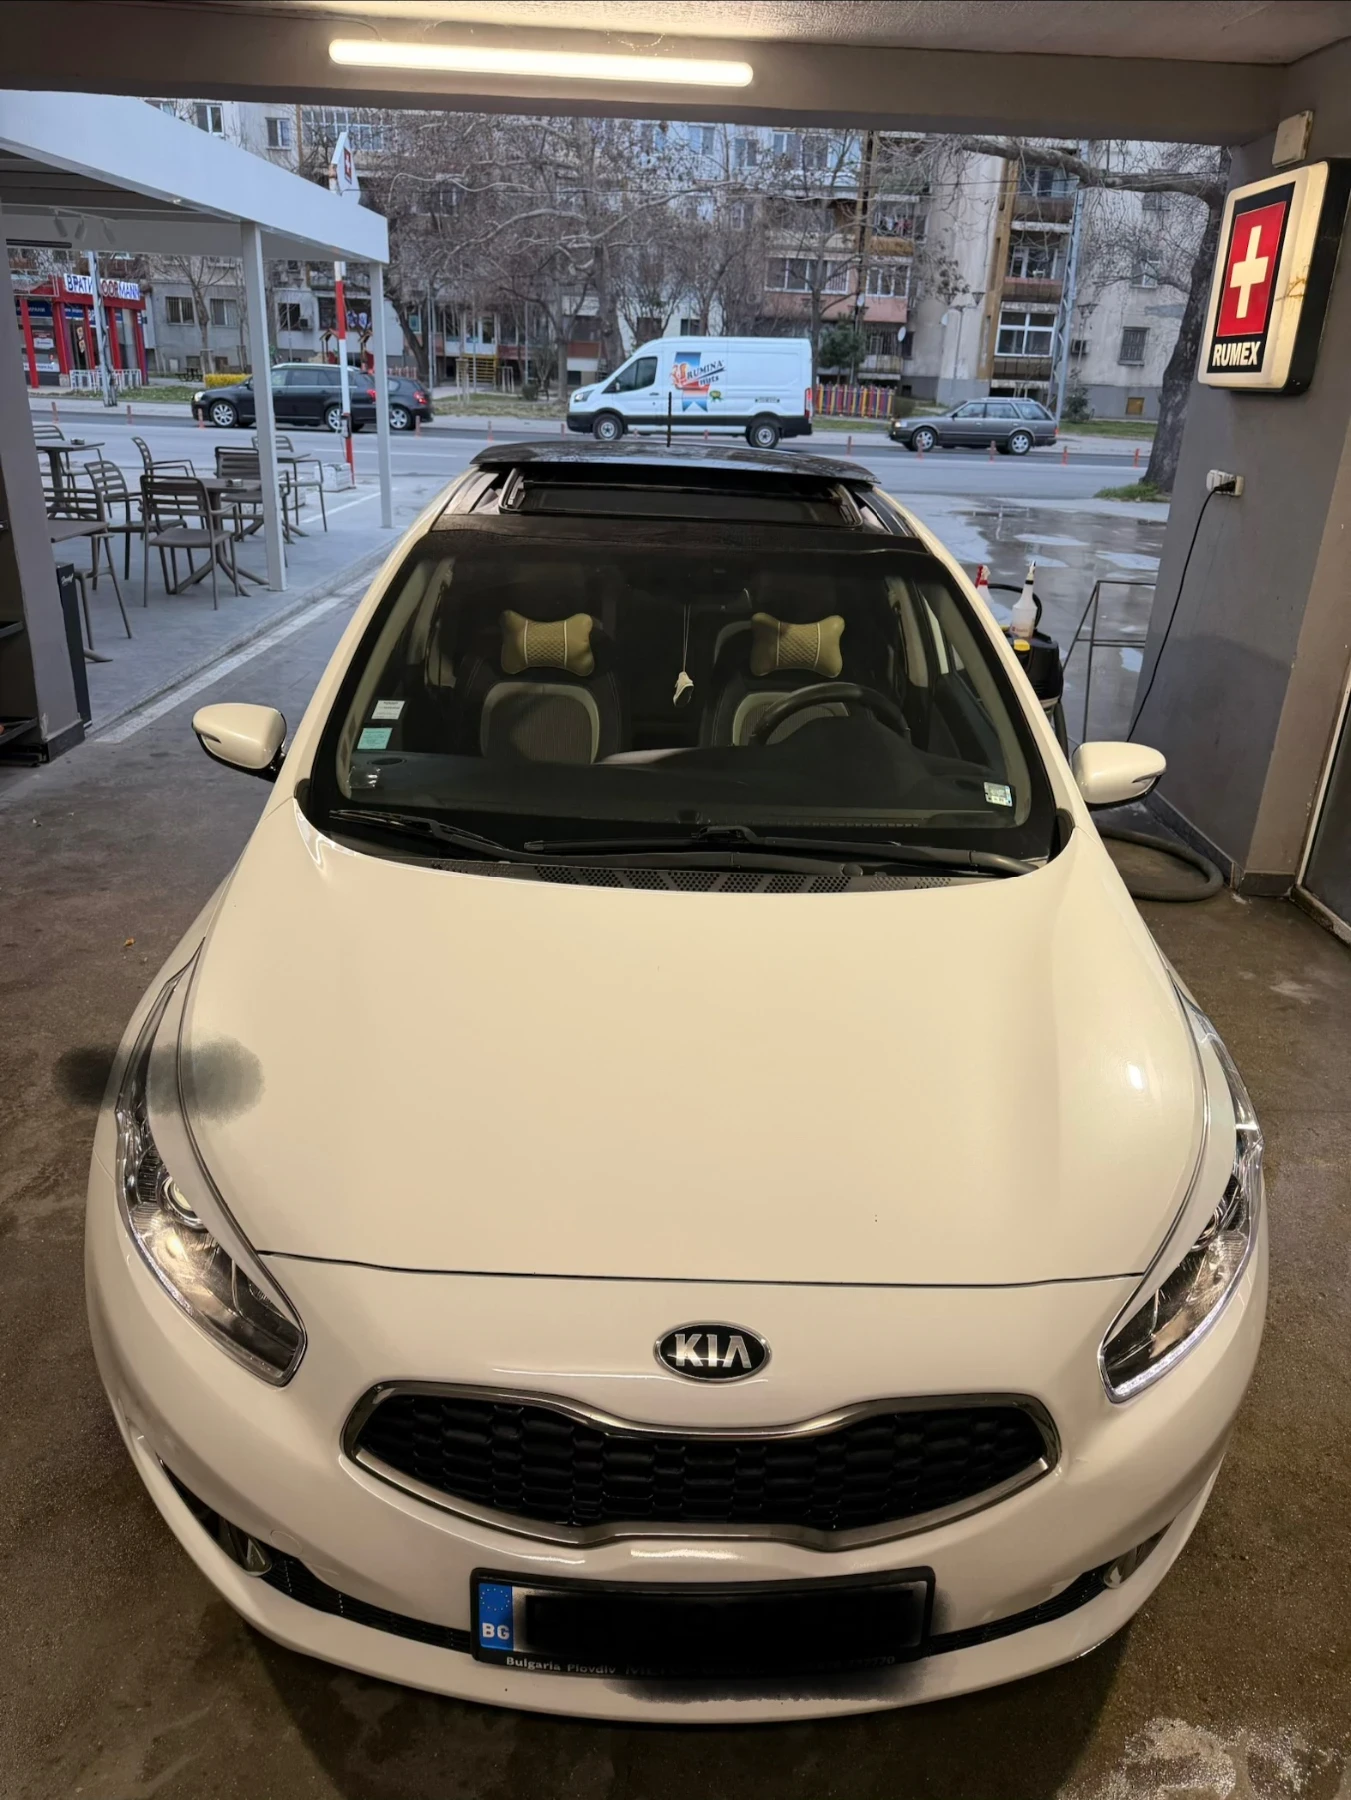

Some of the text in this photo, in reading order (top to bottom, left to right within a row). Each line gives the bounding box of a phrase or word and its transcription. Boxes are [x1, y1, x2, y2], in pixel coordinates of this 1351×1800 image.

[1212, 341, 1261, 367] RUMEX
[687, 360, 724, 380] RUMINA
[674, 1333, 753, 1369] KIA
[482, 1622, 510, 1640] BG
[506, 1656, 562, 1671] Bulgaria
[567, 1663, 617, 1675] Plovdiv
